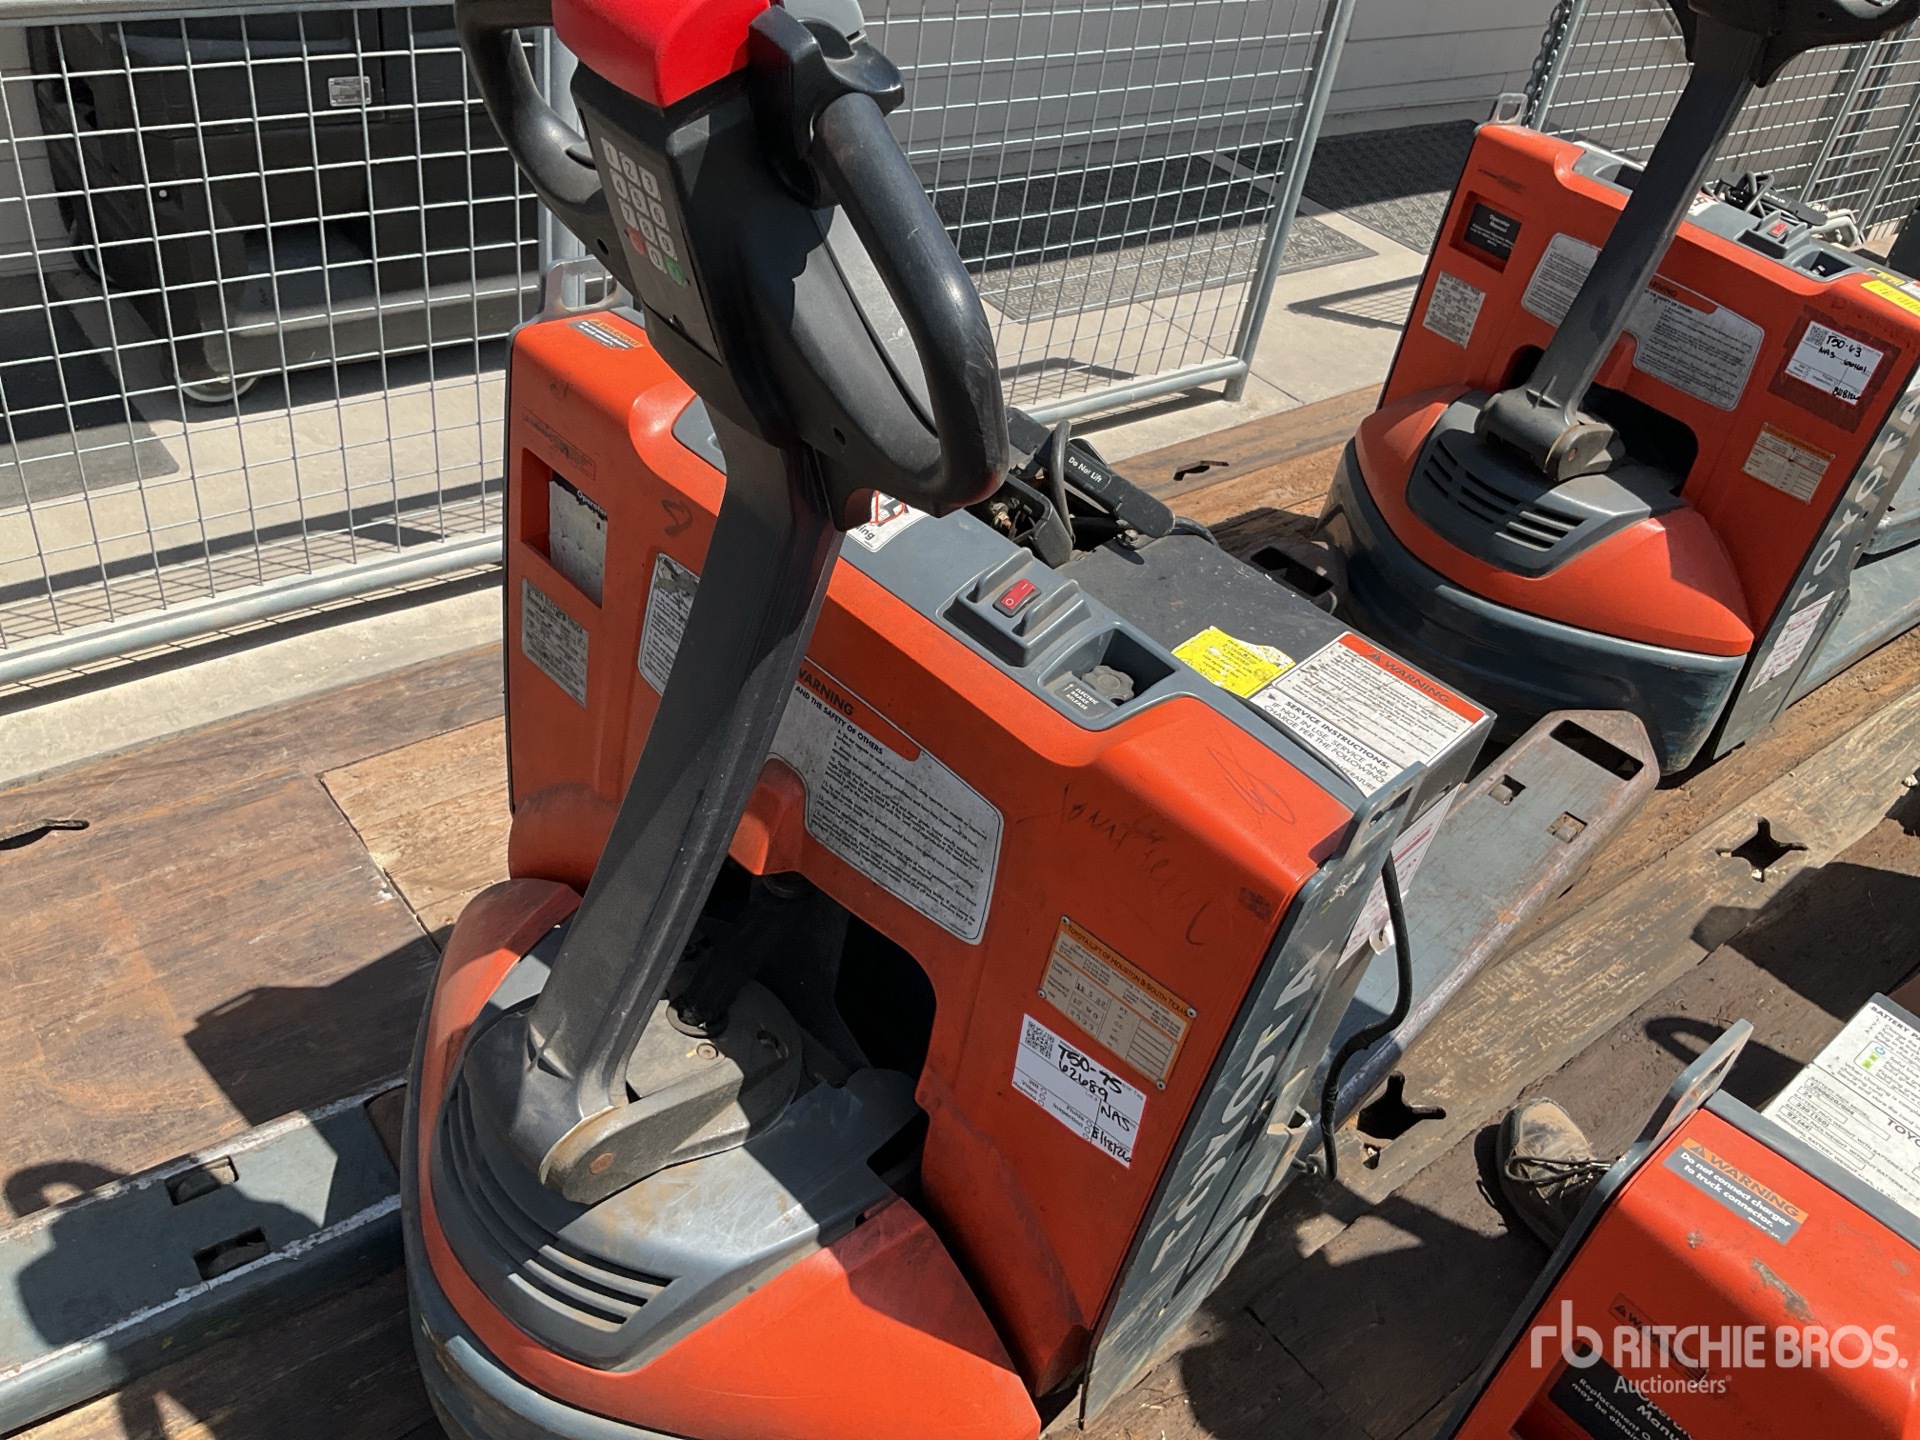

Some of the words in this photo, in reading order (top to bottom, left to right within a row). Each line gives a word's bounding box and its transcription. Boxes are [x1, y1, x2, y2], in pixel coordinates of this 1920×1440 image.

[1068, 456, 1078, 467] Do
[1078, 463, 1091, 475] Not
[1090, 471, 1103, 483] Lift
[1070, 690, 1090, 705] BRAKE
[1075, 688, 1099, 705] ELECTRIC
[1382, 659, 1450, 702] WARNING
[795, 686, 810, 702] AND
[810, 696, 824, 711] THE
[823, 706, 847, 727] SAFETY
[847, 722, 857, 735] OF
[857, 731, 884, 755] OTHERS
[1065, 693, 1088, 711] RELEASE
[1285, 701, 1322, 725] SERVICE
[1264, 704, 1298, 729] CHARGE
[1299, 726, 1316, 739] PER
[1315, 737, 1333, 750] THE
[1281, 706, 1301, 720] NOT
[1299, 717, 1312, 727] IN
[1333, 739, 1366, 763] SERVICE
[1366, 762, 1388, 777] AND
[1068, 925, 1089, 944] TOYOTA
[1870, 1006, 1910, 1032] BATTERY
[1058, 1059, 1108, 1103] 62689
[1100, 1104, 1132, 1133] NAS
[1680, 1151, 1695, 1165] Do
[1695, 1162, 1714, 1176] not
[1713, 1173, 1752, 1201] connect
[1751, 1197, 1792, 1228] charger
[1684, 1164, 1695, 1175] to
[1695, 1171, 1723, 1194] truck
[1722, 1191, 1774, 1228] connector.
[1710, 1154, 1800, 1217] WARNING
[1571, 1383, 1594, 1402] may
[1594, 1401, 1608, 1415] be
[1579, 1377, 1641, 1432] Replacement
